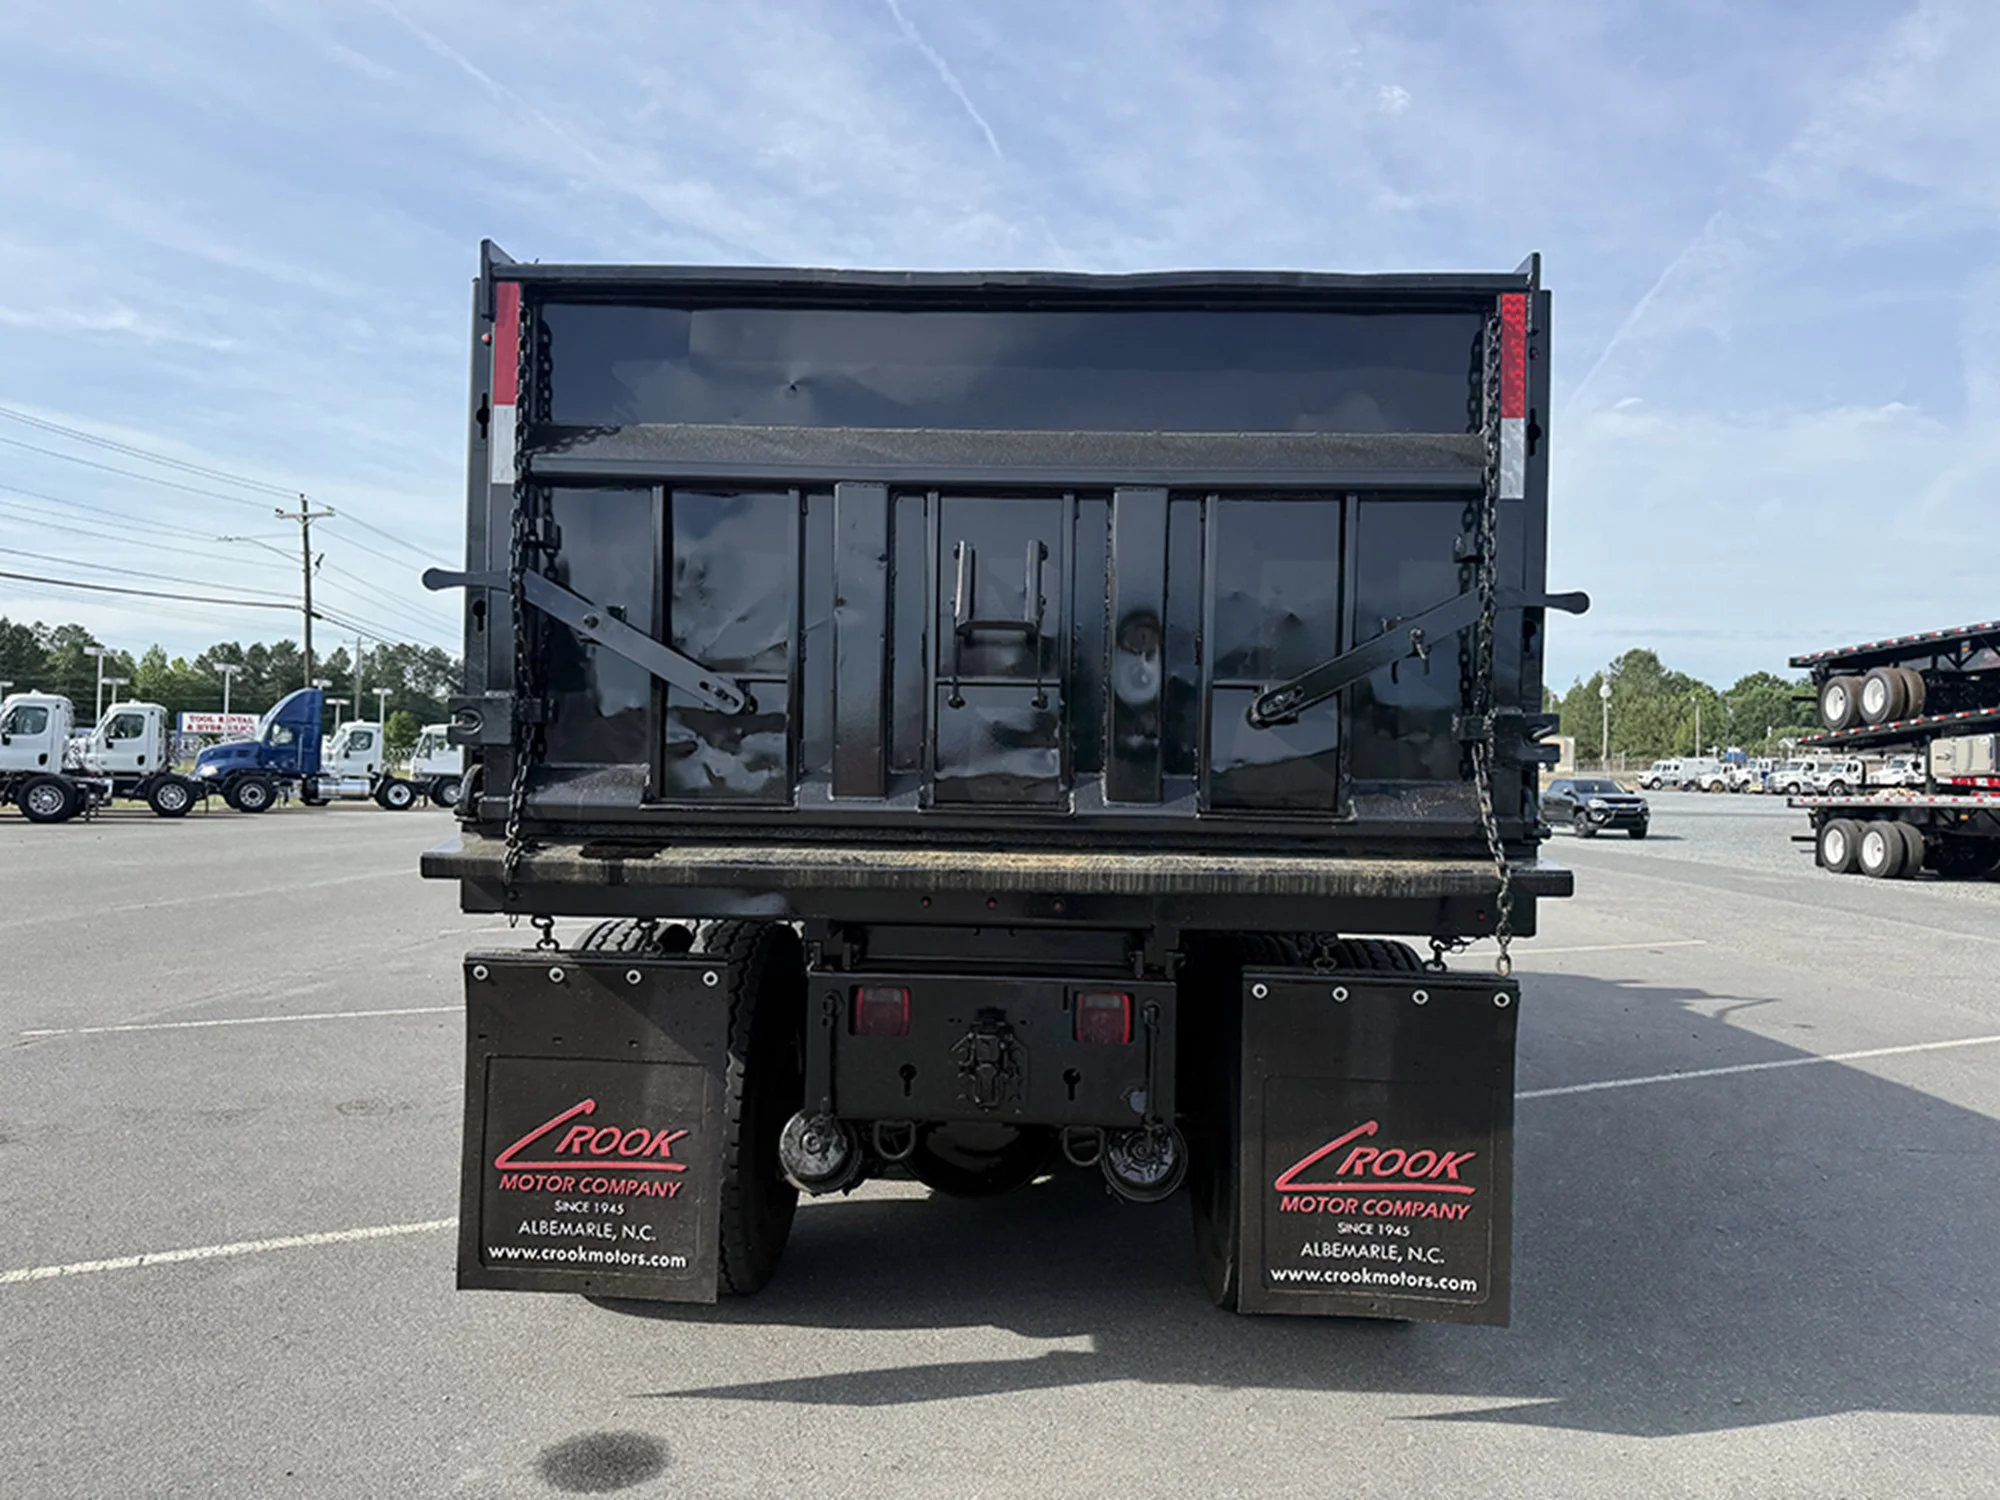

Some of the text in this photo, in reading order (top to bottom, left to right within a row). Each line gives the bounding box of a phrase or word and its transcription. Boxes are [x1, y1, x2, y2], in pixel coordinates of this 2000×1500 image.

[189, 715, 254, 723] TOOL RNTAL
[494, 1099, 687, 1172] CROOK
[1275, 1121, 1476, 1195] CROOK
[500, 1174, 681, 1198] MOTOR COMPANY
[554, 1200, 625, 1216] SINCE 1945
[1280, 1196, 1470, 1220] MOTOR COMPANY
[518, 1219, 657, 1242] ALBEMARLE, N.C.
[1337, 1222, 1411, 1238] SINCE 1945
[488, 1245, 687, 1268] www.crookmotors.com
[1301, 1242, 1446, 1264] ALBEMARLE, N.C.
[1270, 1267, 1478, 1293] www.crookmotors.com
